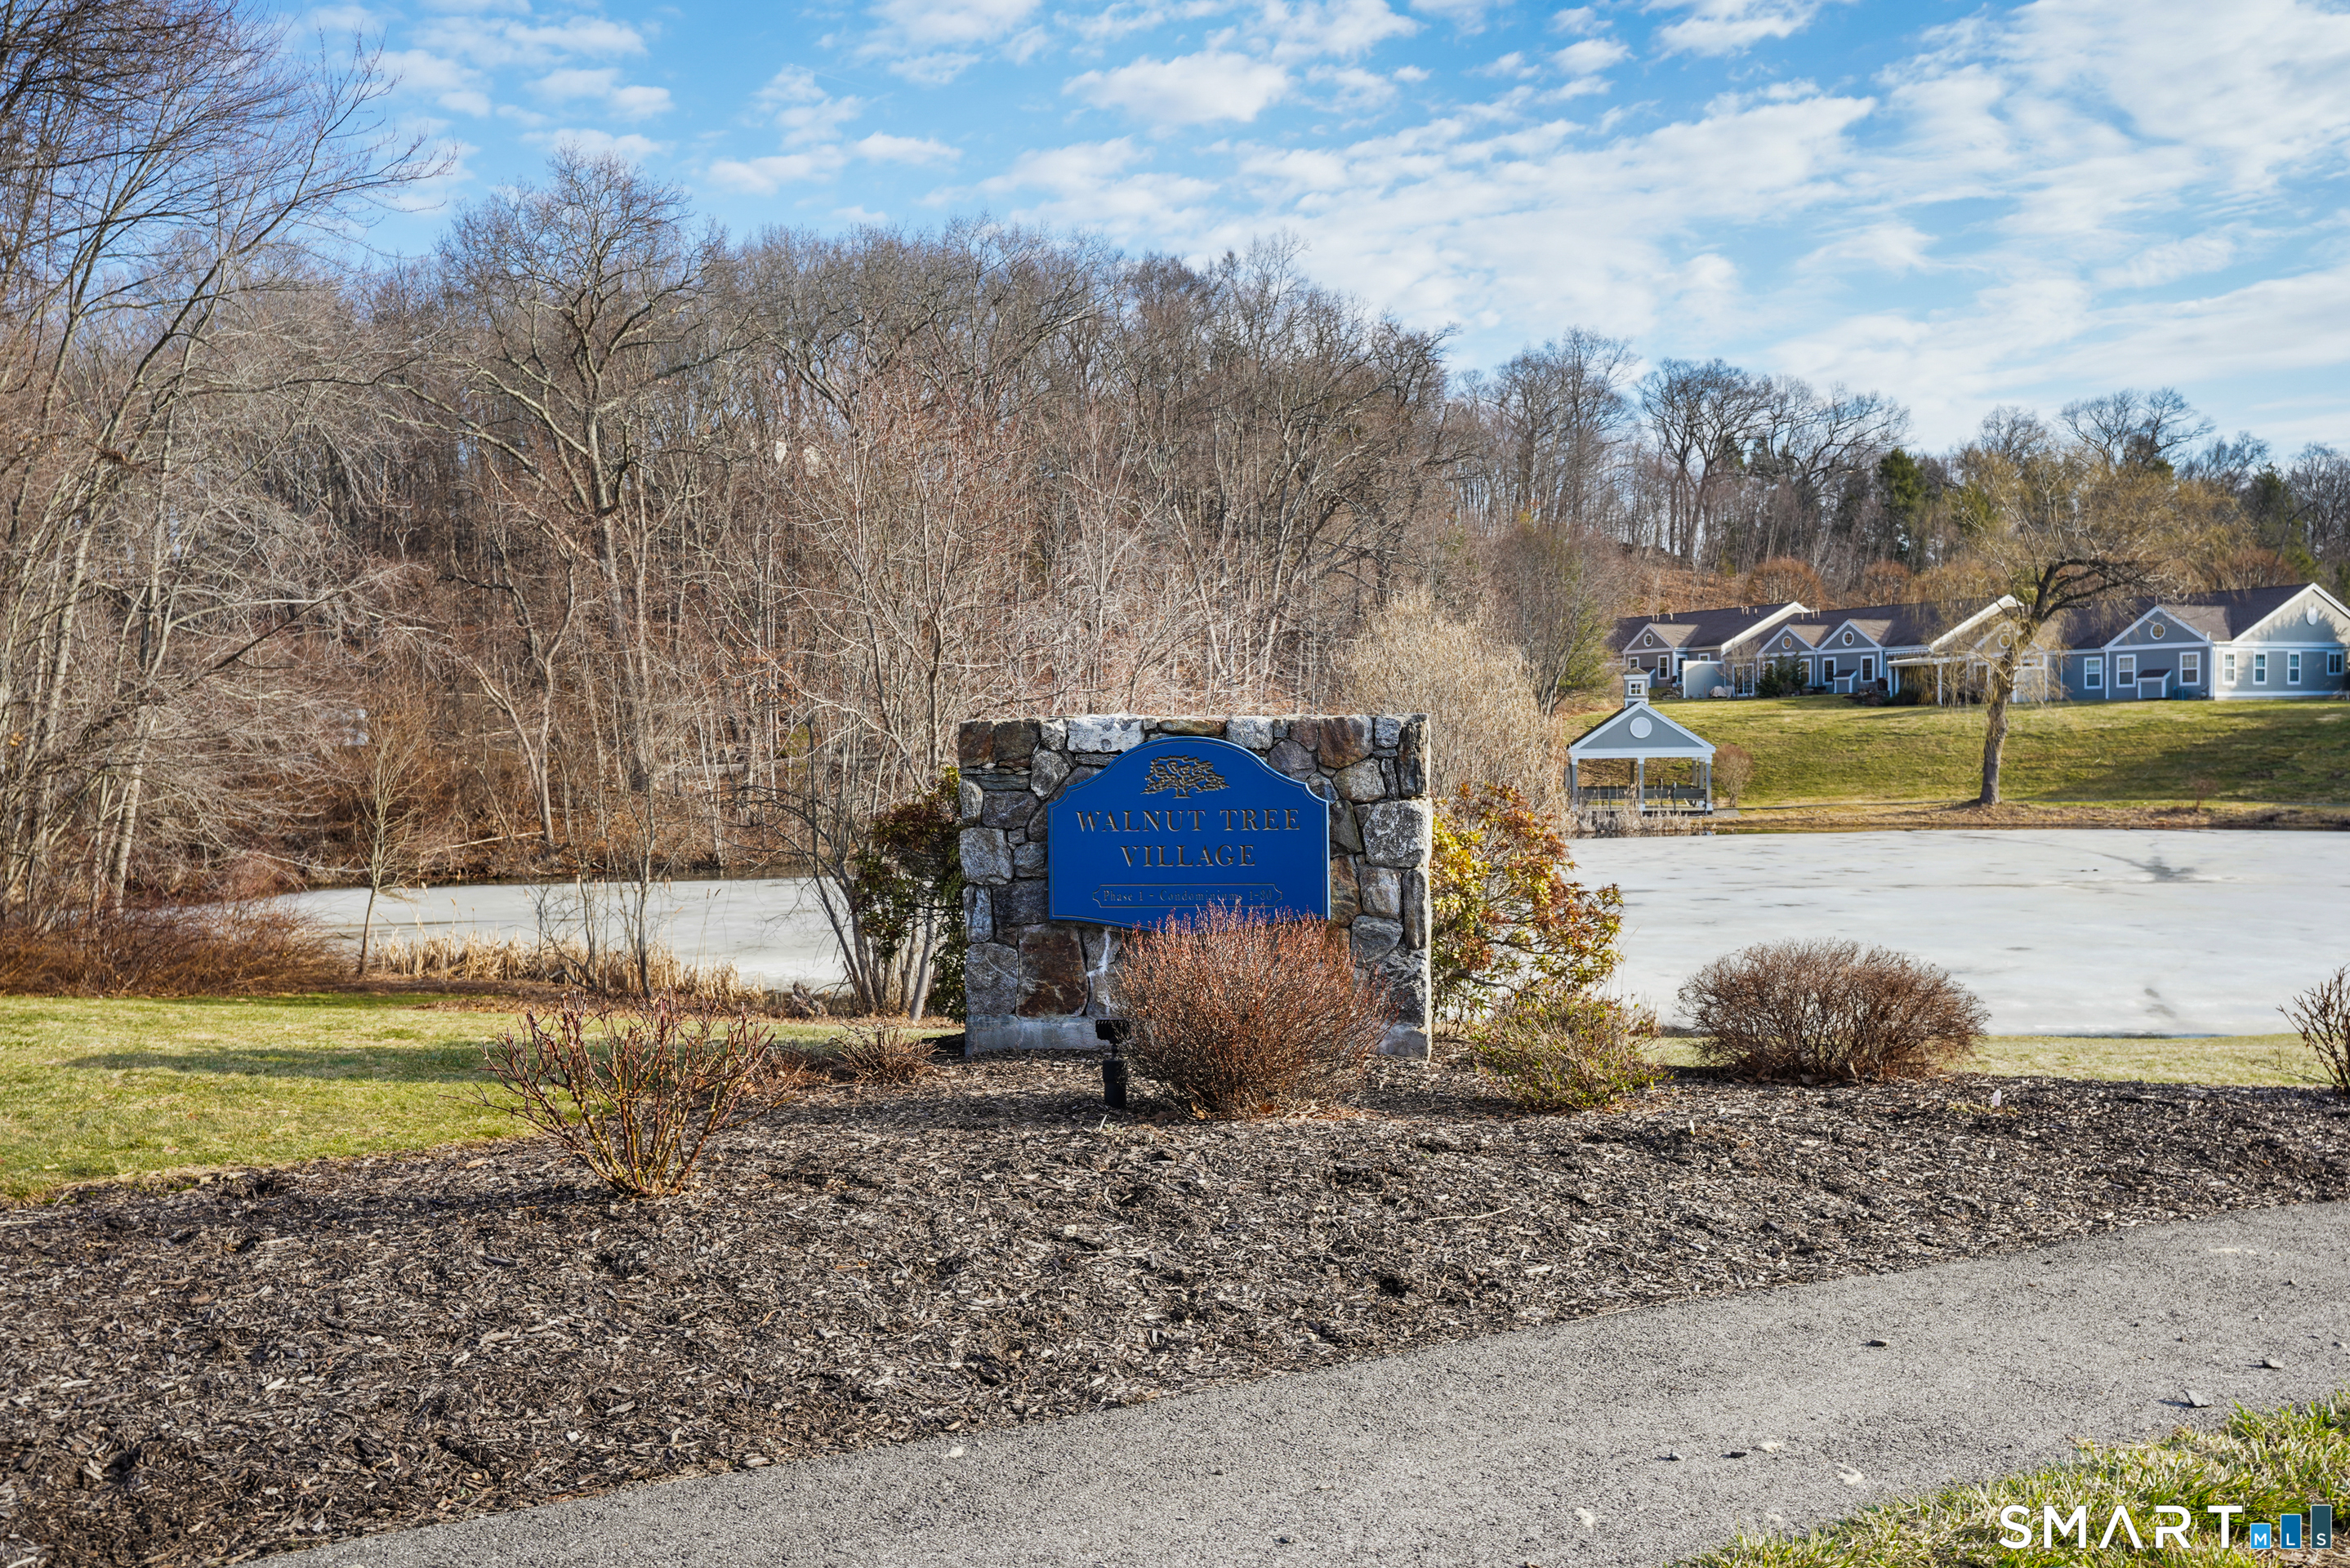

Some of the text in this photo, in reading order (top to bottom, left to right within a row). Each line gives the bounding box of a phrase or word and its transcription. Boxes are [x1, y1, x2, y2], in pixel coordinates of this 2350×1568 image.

[1076, 808, 1301, 832] WALNUT TREE
[1120, 844, 1256, 867] VILLAGE
[1104, 889, 1133, 902] Phase
[1139, 889, 1144, 902] 1
[1160, 889, 1243, 901] Condominium
